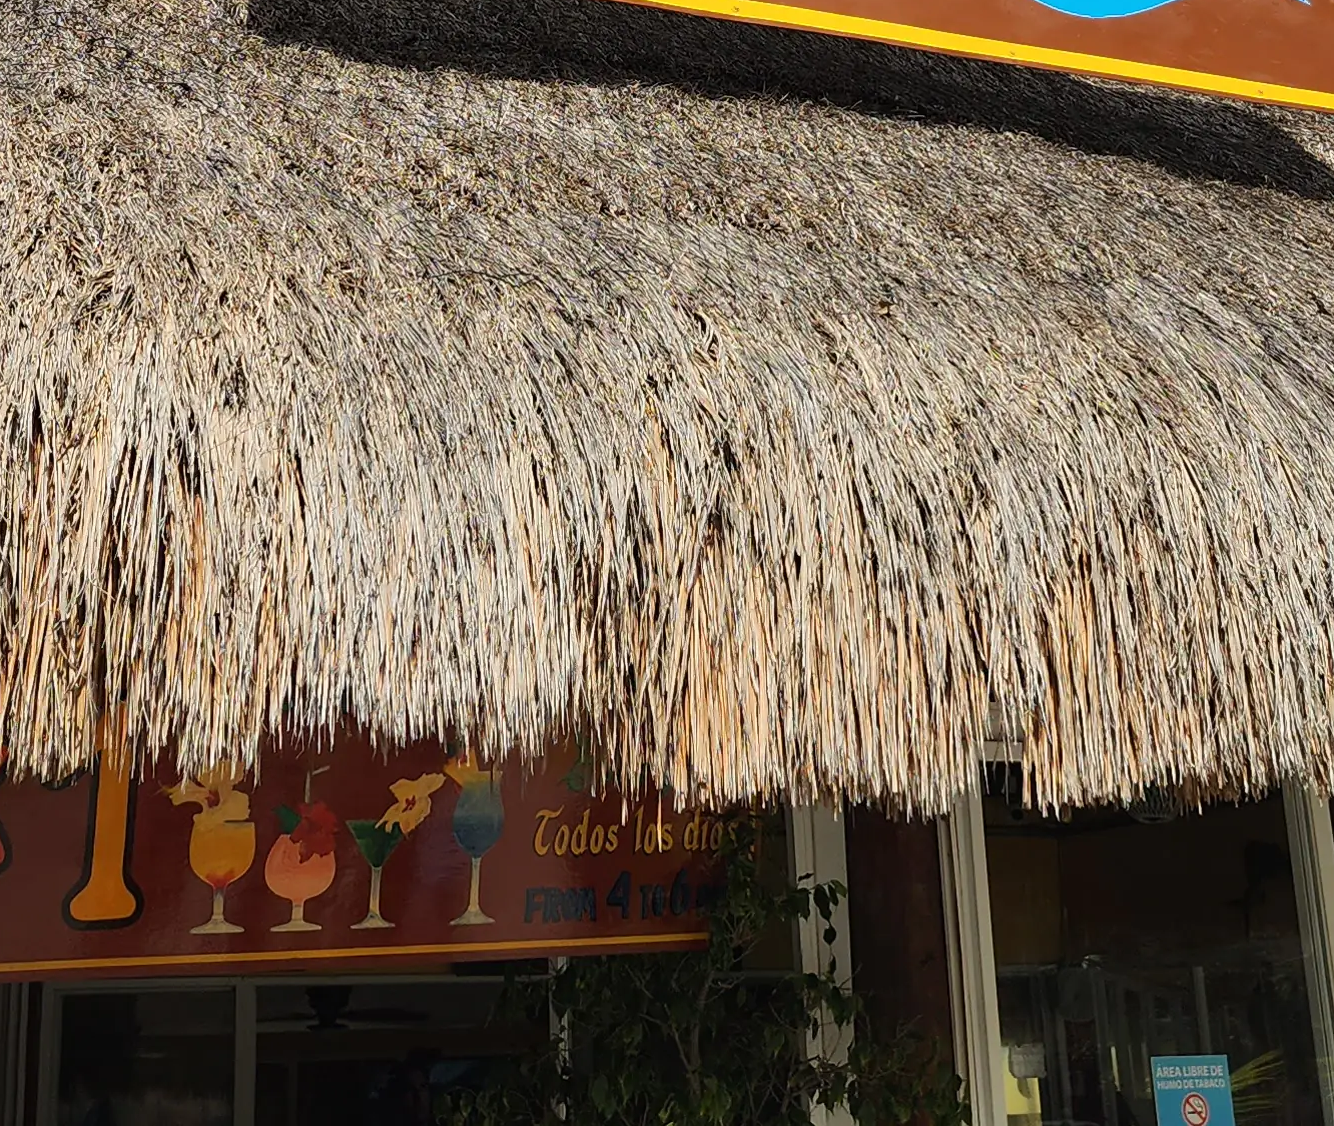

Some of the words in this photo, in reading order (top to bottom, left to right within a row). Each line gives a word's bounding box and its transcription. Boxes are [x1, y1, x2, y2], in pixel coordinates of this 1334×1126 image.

[534, 805, 619, 856] Todos
[634, 805, 674, 854] los
[524, 887, 597, 923] FROM
[607, 871, 632, 919] 4
[640, 884, 665, 920] TO
[670, 867, 692, 915] 6
[1157, 1080, 1182, 1089] HUMO
[1183, 1080, 1195, 1089] DE
[1195, 1078, 1226, 1088] TABACO
[1183, 1065, 1210, 1077] LIBRE
[1211, 1065, 1224, 1076] DE
